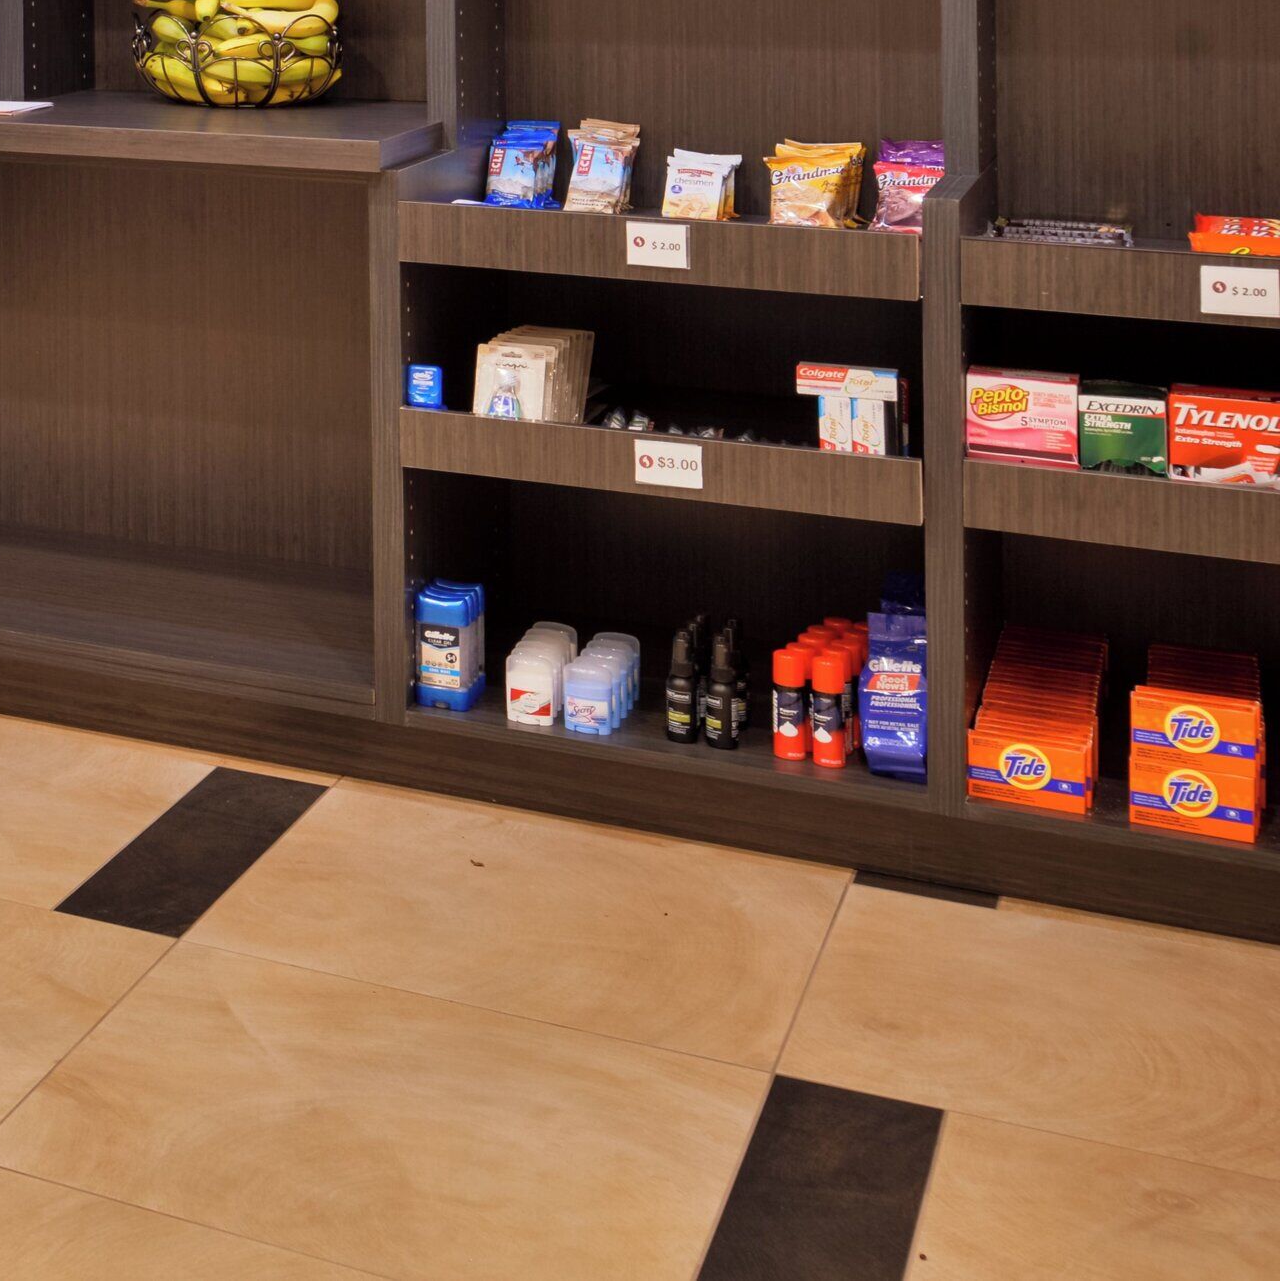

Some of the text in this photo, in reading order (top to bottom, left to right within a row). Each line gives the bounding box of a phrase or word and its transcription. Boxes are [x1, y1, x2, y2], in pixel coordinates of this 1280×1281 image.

[674, 177, 714, 187] chessmen
[661, 241, 681, 251] 2.00
[1242, 287, 1267, 298] 2.00
[800, 367, 845, 379] Colgate
[849, 378, 874, 386] Total
[970, 386, 1029, 403] Pepto-
[978, 401, 1028, 416] Bismol
[1086, 400, 1159, 416] EXCEDRIN
[1029, 417, 1066, 426] SYMPTOM
[1173, 402, 1280, 432] TYLENOL
[1084, 420, 1131, 430] STRENGTH
[1174, 434, 1243, 448] Extra Strength
[658, 457, 698, 471] $3.00
[869, 657, 922, 672] Gillette
[876, 681, 909, 690] News!
[880, 674, 908, 683] Good
[1170, 717, 1215, 741] Tide
[1004, 755, 1047, 778] Tide
[1169, 781, 1213, 805] Tide
